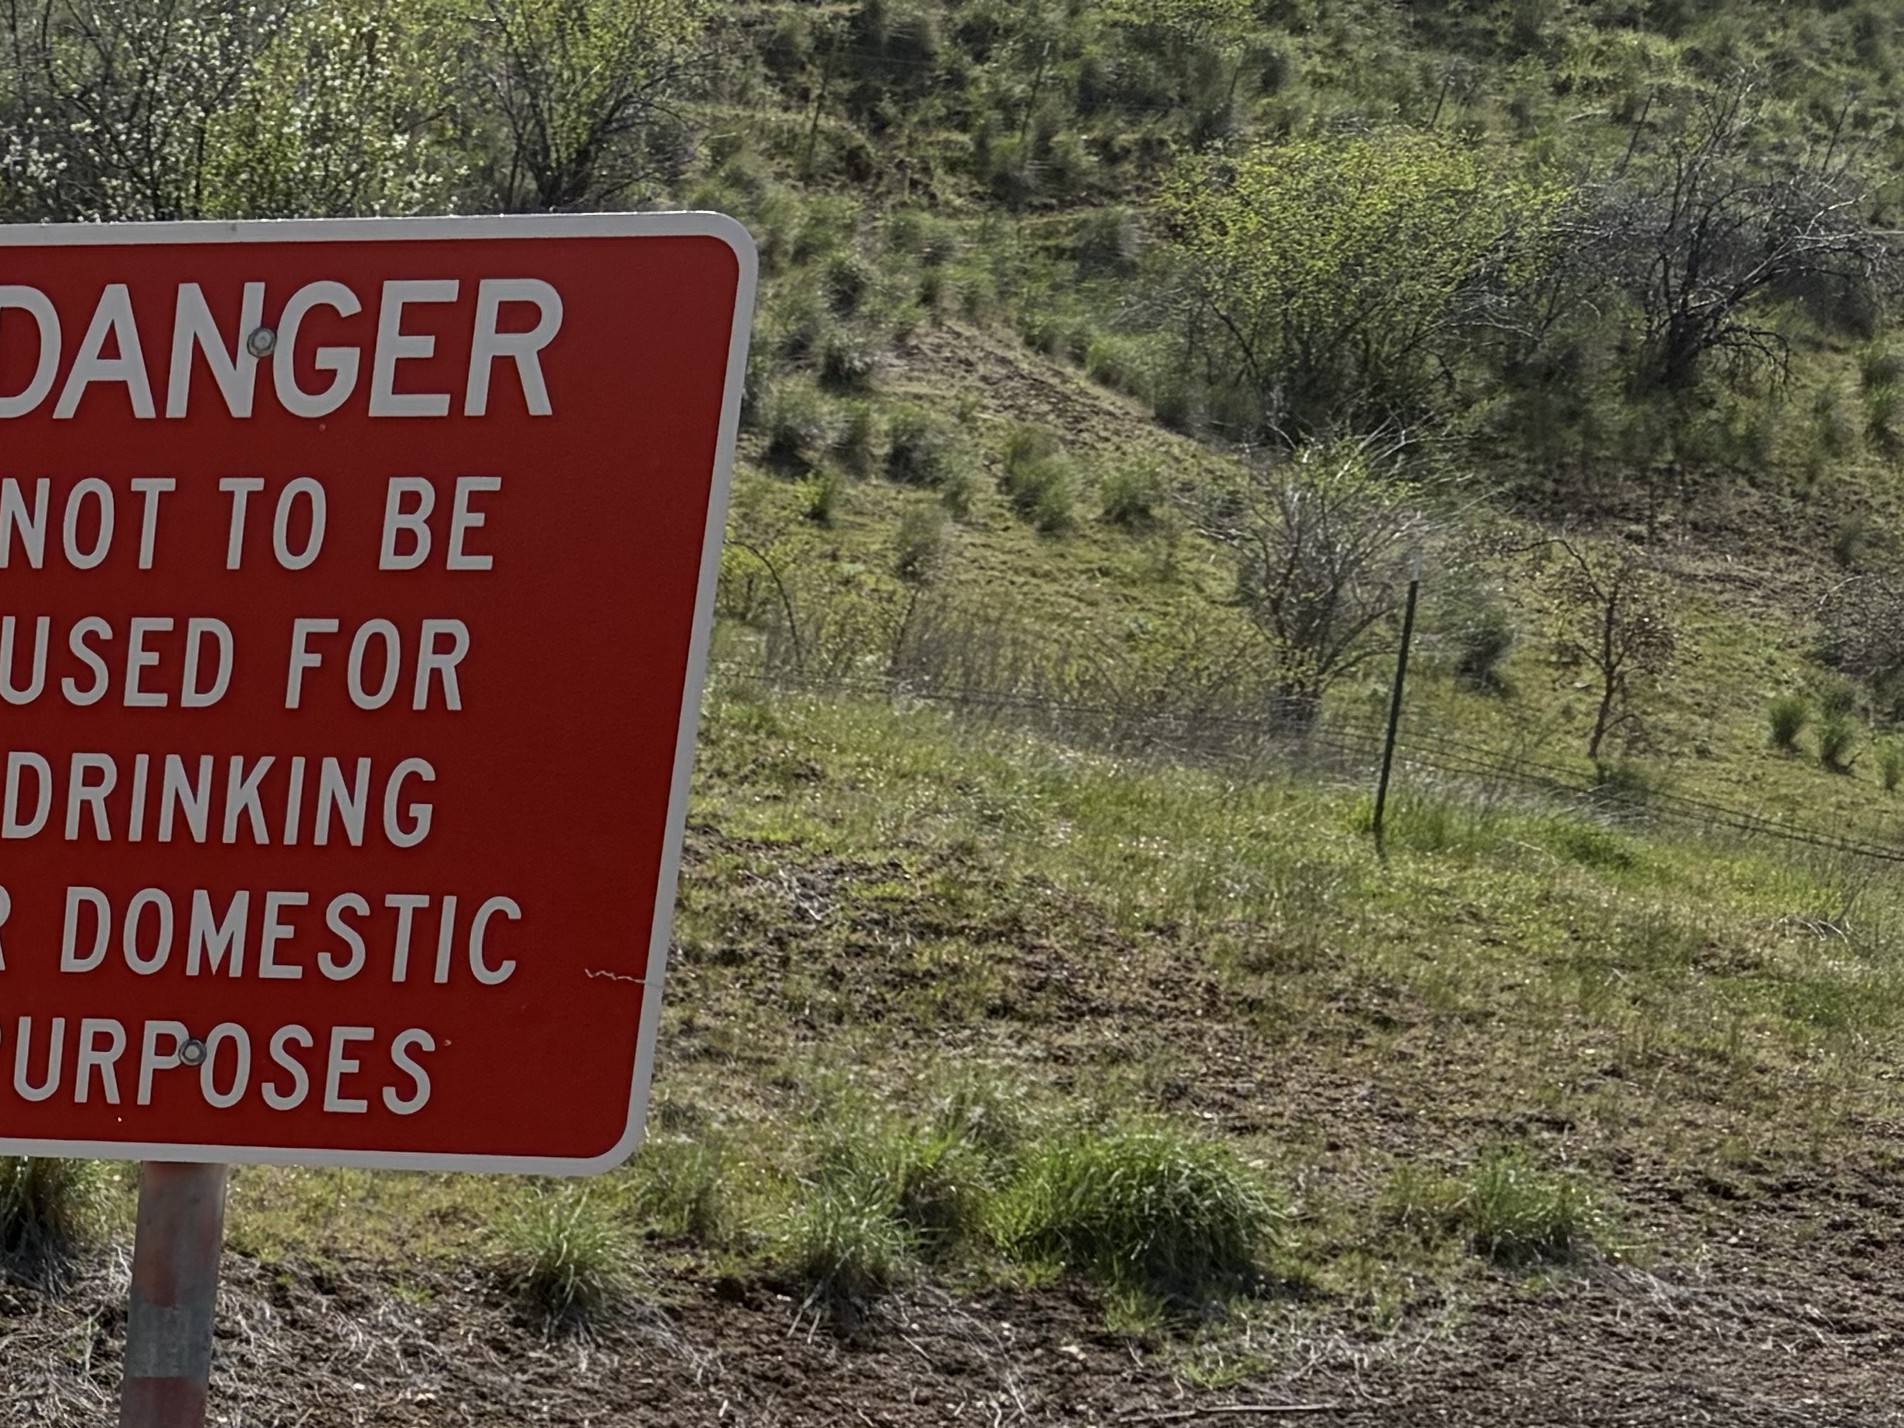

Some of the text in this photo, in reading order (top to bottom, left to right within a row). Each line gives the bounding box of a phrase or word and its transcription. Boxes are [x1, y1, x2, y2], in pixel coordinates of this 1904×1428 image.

[218, 475, 328, 571] TO
[378, 475, 503, 571] BE
[284, 617, 471, 712] FOR
[0, 750, 437, 849] DRINKING
[59, 885, 523, 986] DOMESTIC
